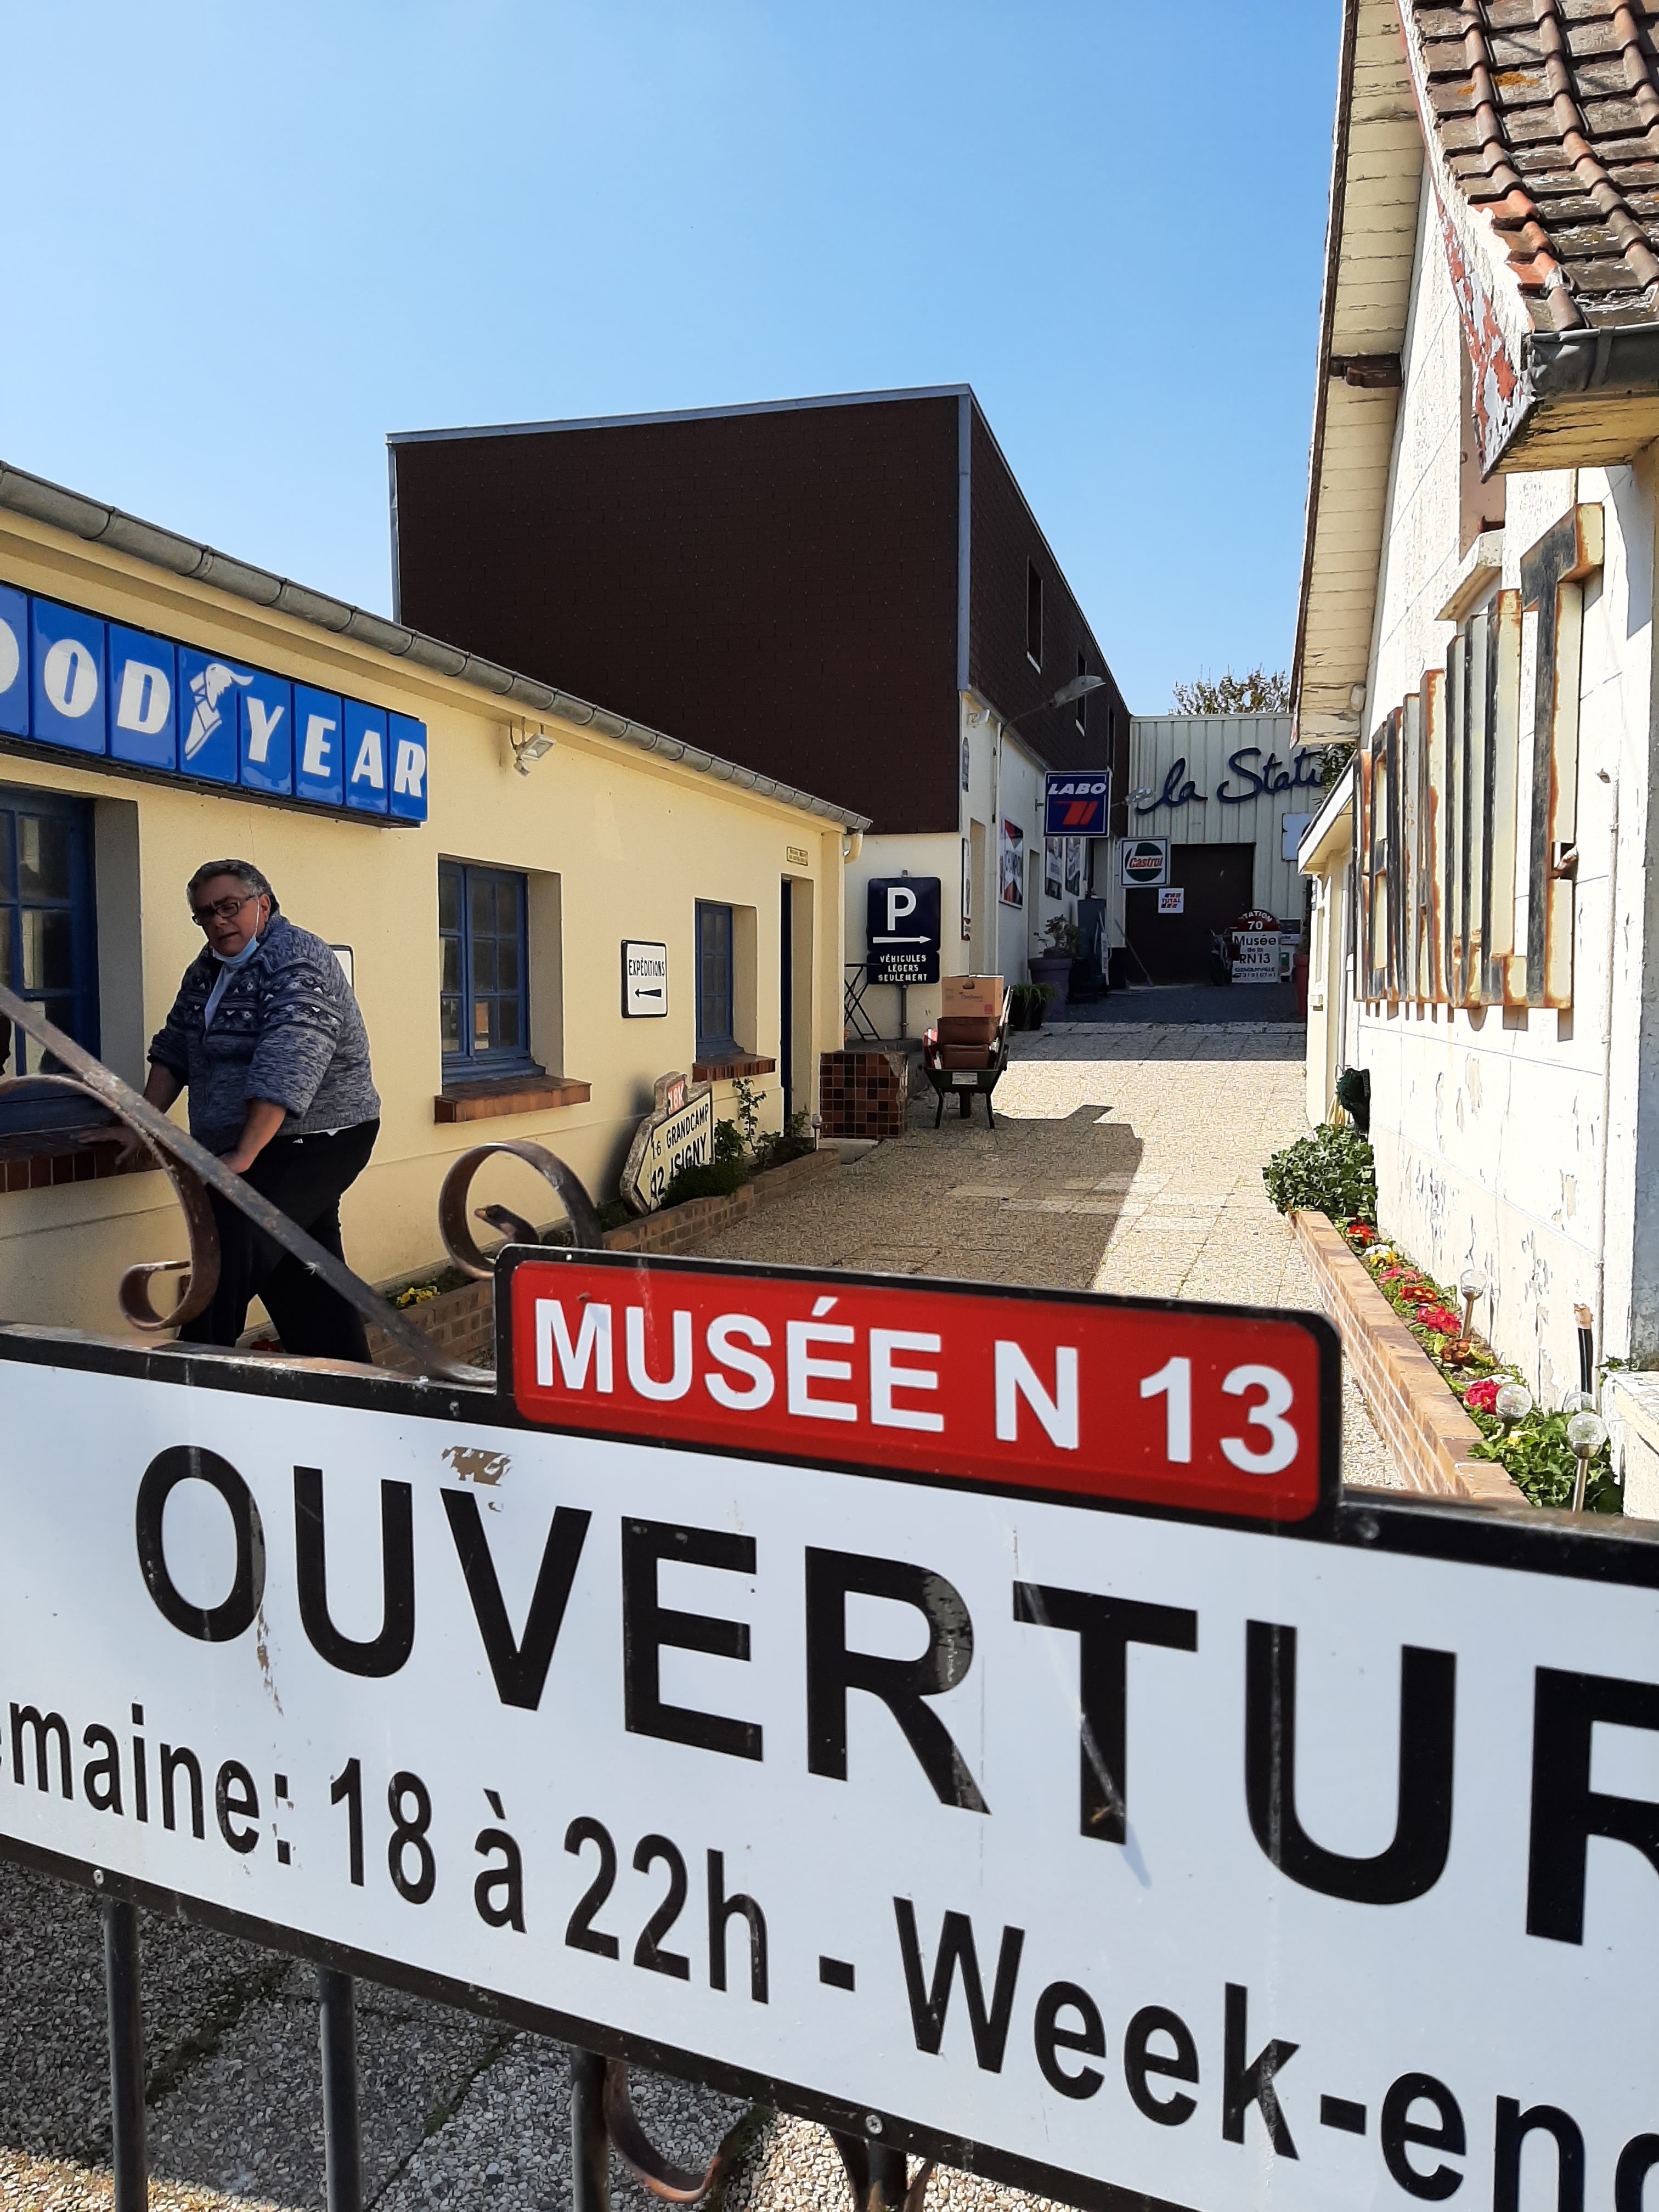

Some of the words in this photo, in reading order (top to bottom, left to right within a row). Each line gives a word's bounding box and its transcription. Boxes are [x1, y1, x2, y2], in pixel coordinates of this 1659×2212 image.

[1047, 783, 1107, 795] LABO
[1136, 757, 1207, 815] la
[1216, 747, 1324, 804] Stati
[1129, 857, 1163, 868] Castrol
[887, 887, 917, 931] P
[1248, 921, 1263, 930] 70
[1234, 935, 1277, 946] Musée
[880, 953, 927, 963] VÉHICULES
[629, 957, 664, 977] EXPÉDITIONS
[888, 963, 919, 972] LÉGERS
[878, 973, 928, 982] SEULEMENT
[667, 1103, 709, 1149] GRANDCAMP
[651, 1166, 666, 1199] 12
[670, 1132, 707, 1178] ISIGNY
[535, 1296, 945, 1432] MUSÉE
[994, 1340, 1079, 1450] N
[1139, 1357, 1299, 1475] 13
[0, 1702, 291, 1865] maine:
[331, 1757, 437, 1905] 18
[475, 1788, 527, 1934] à
[563, 1816, 769, 2005] 22h
[819, 1955, 855, 1992] -
